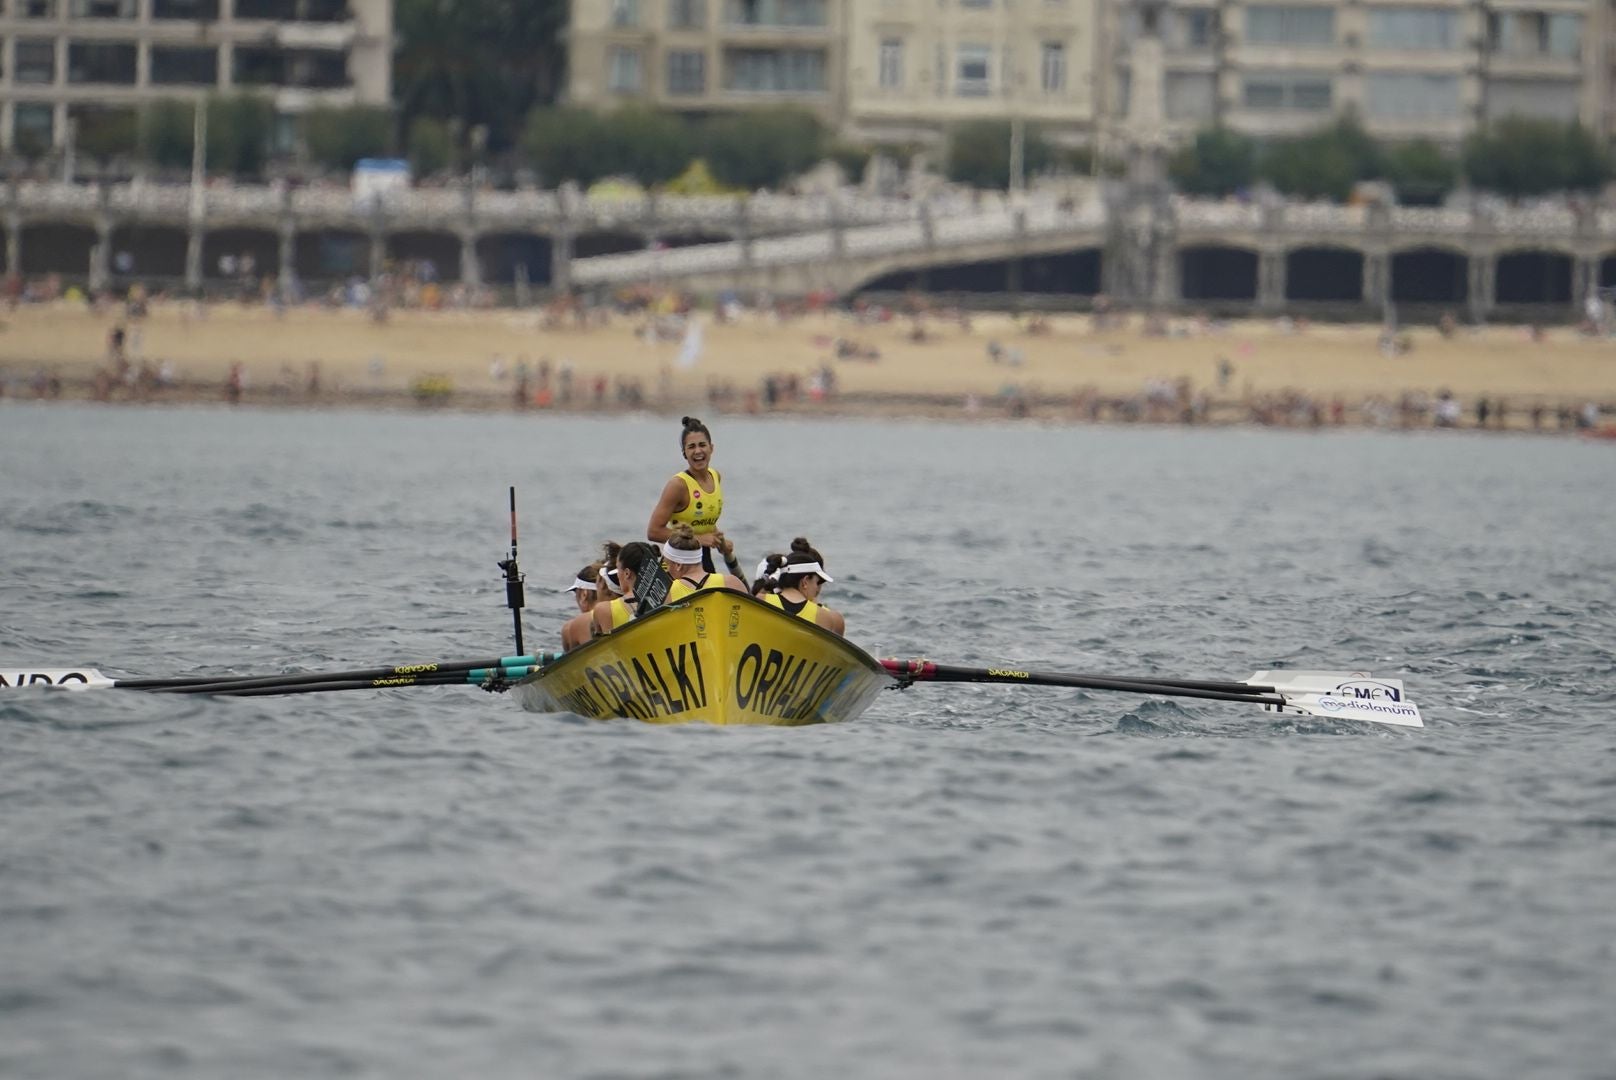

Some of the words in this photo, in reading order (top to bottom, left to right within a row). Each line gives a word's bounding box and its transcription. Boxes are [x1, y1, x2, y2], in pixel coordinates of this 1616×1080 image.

[395, 663, 438, 674] SAGARDI
[988, 667, 1029, 678] SAGARDI
[585, 641, 707, 720] ORIALKI
[736, 643, 842, 720] ORIALKI
[1323, 700, 1416, 716] mediolanum
